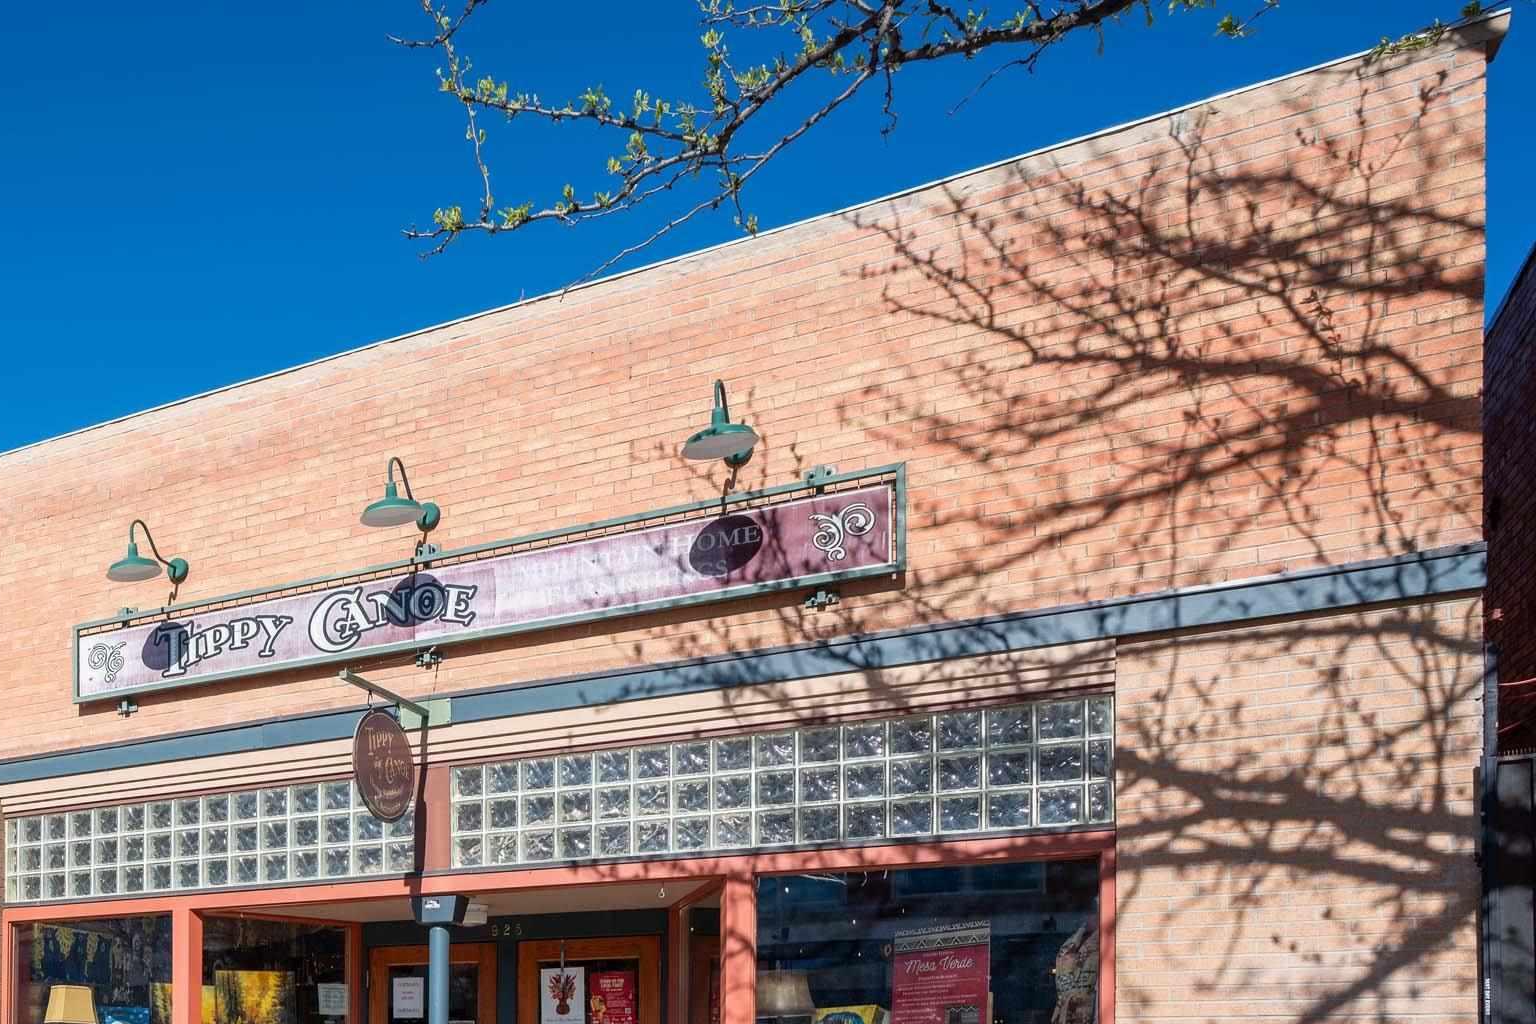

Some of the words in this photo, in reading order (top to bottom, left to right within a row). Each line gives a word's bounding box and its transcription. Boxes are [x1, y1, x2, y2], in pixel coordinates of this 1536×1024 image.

[670, 524, 762, 555] HOME
[154, 614, 294, 678] TIPPY
[308, 583, 480, 654] CANOE
[365, 727, 395, 756] TIPPY
[491, 923, 523, 937] 925
[904, 959, 937, 976] Mesa
[939, 955, 973, 970] Verde
